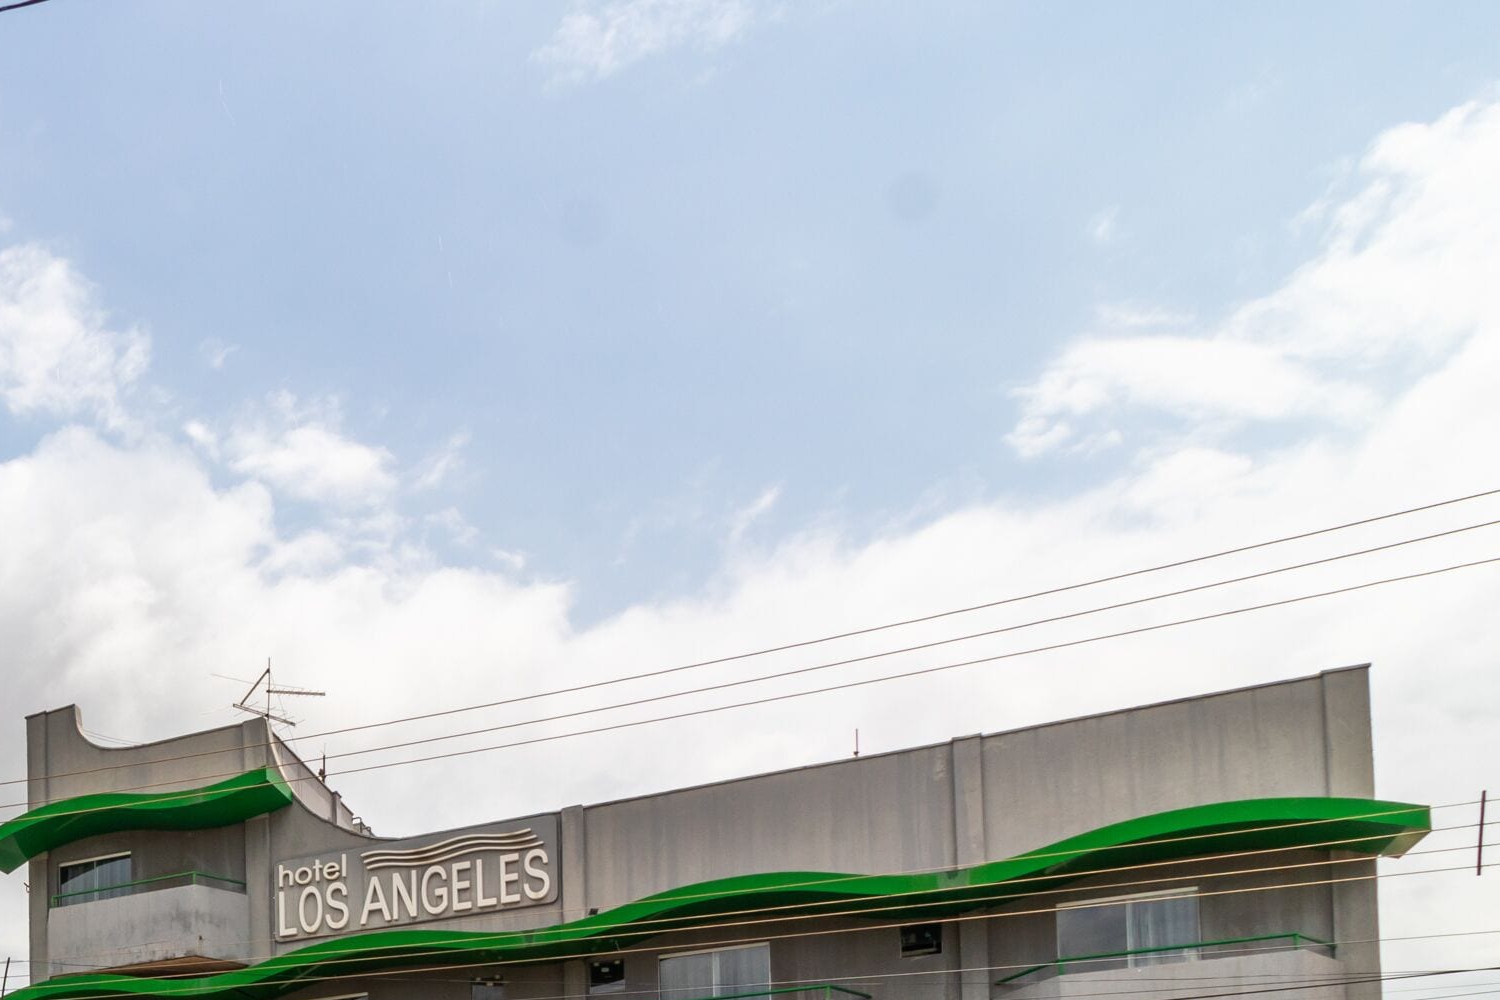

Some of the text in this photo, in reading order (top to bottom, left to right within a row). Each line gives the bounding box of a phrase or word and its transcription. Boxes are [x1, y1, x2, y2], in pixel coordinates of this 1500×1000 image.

[278, 853, 347, 888] hotel
[278, 848, 550, 937] LOS ANGELES
